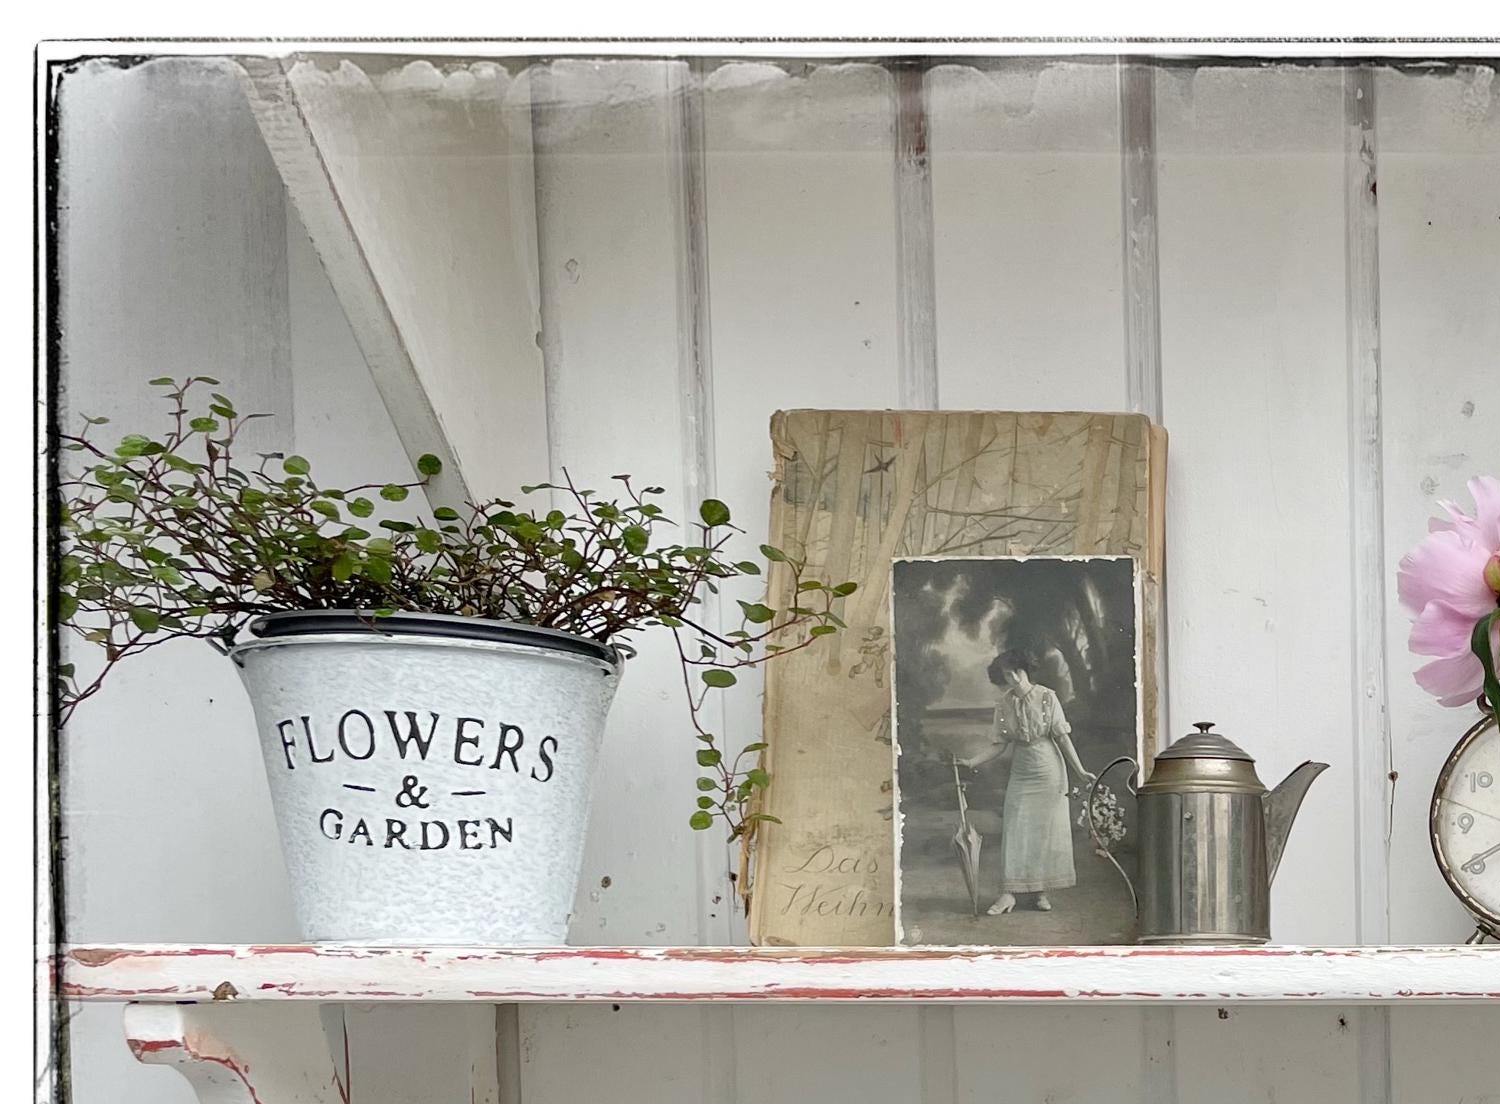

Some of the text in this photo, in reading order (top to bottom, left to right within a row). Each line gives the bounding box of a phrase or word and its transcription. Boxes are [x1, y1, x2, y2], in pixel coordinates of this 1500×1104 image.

[276, 709, 558, 782] FLOWERS
[395, 775, 430, 809] &
[1469, 771, 1493, 792] 10
[319, 808, 513, 850] GARDEN
[1457, 812, 1475, 834] 9
[782, 844, 879, 874] Das
